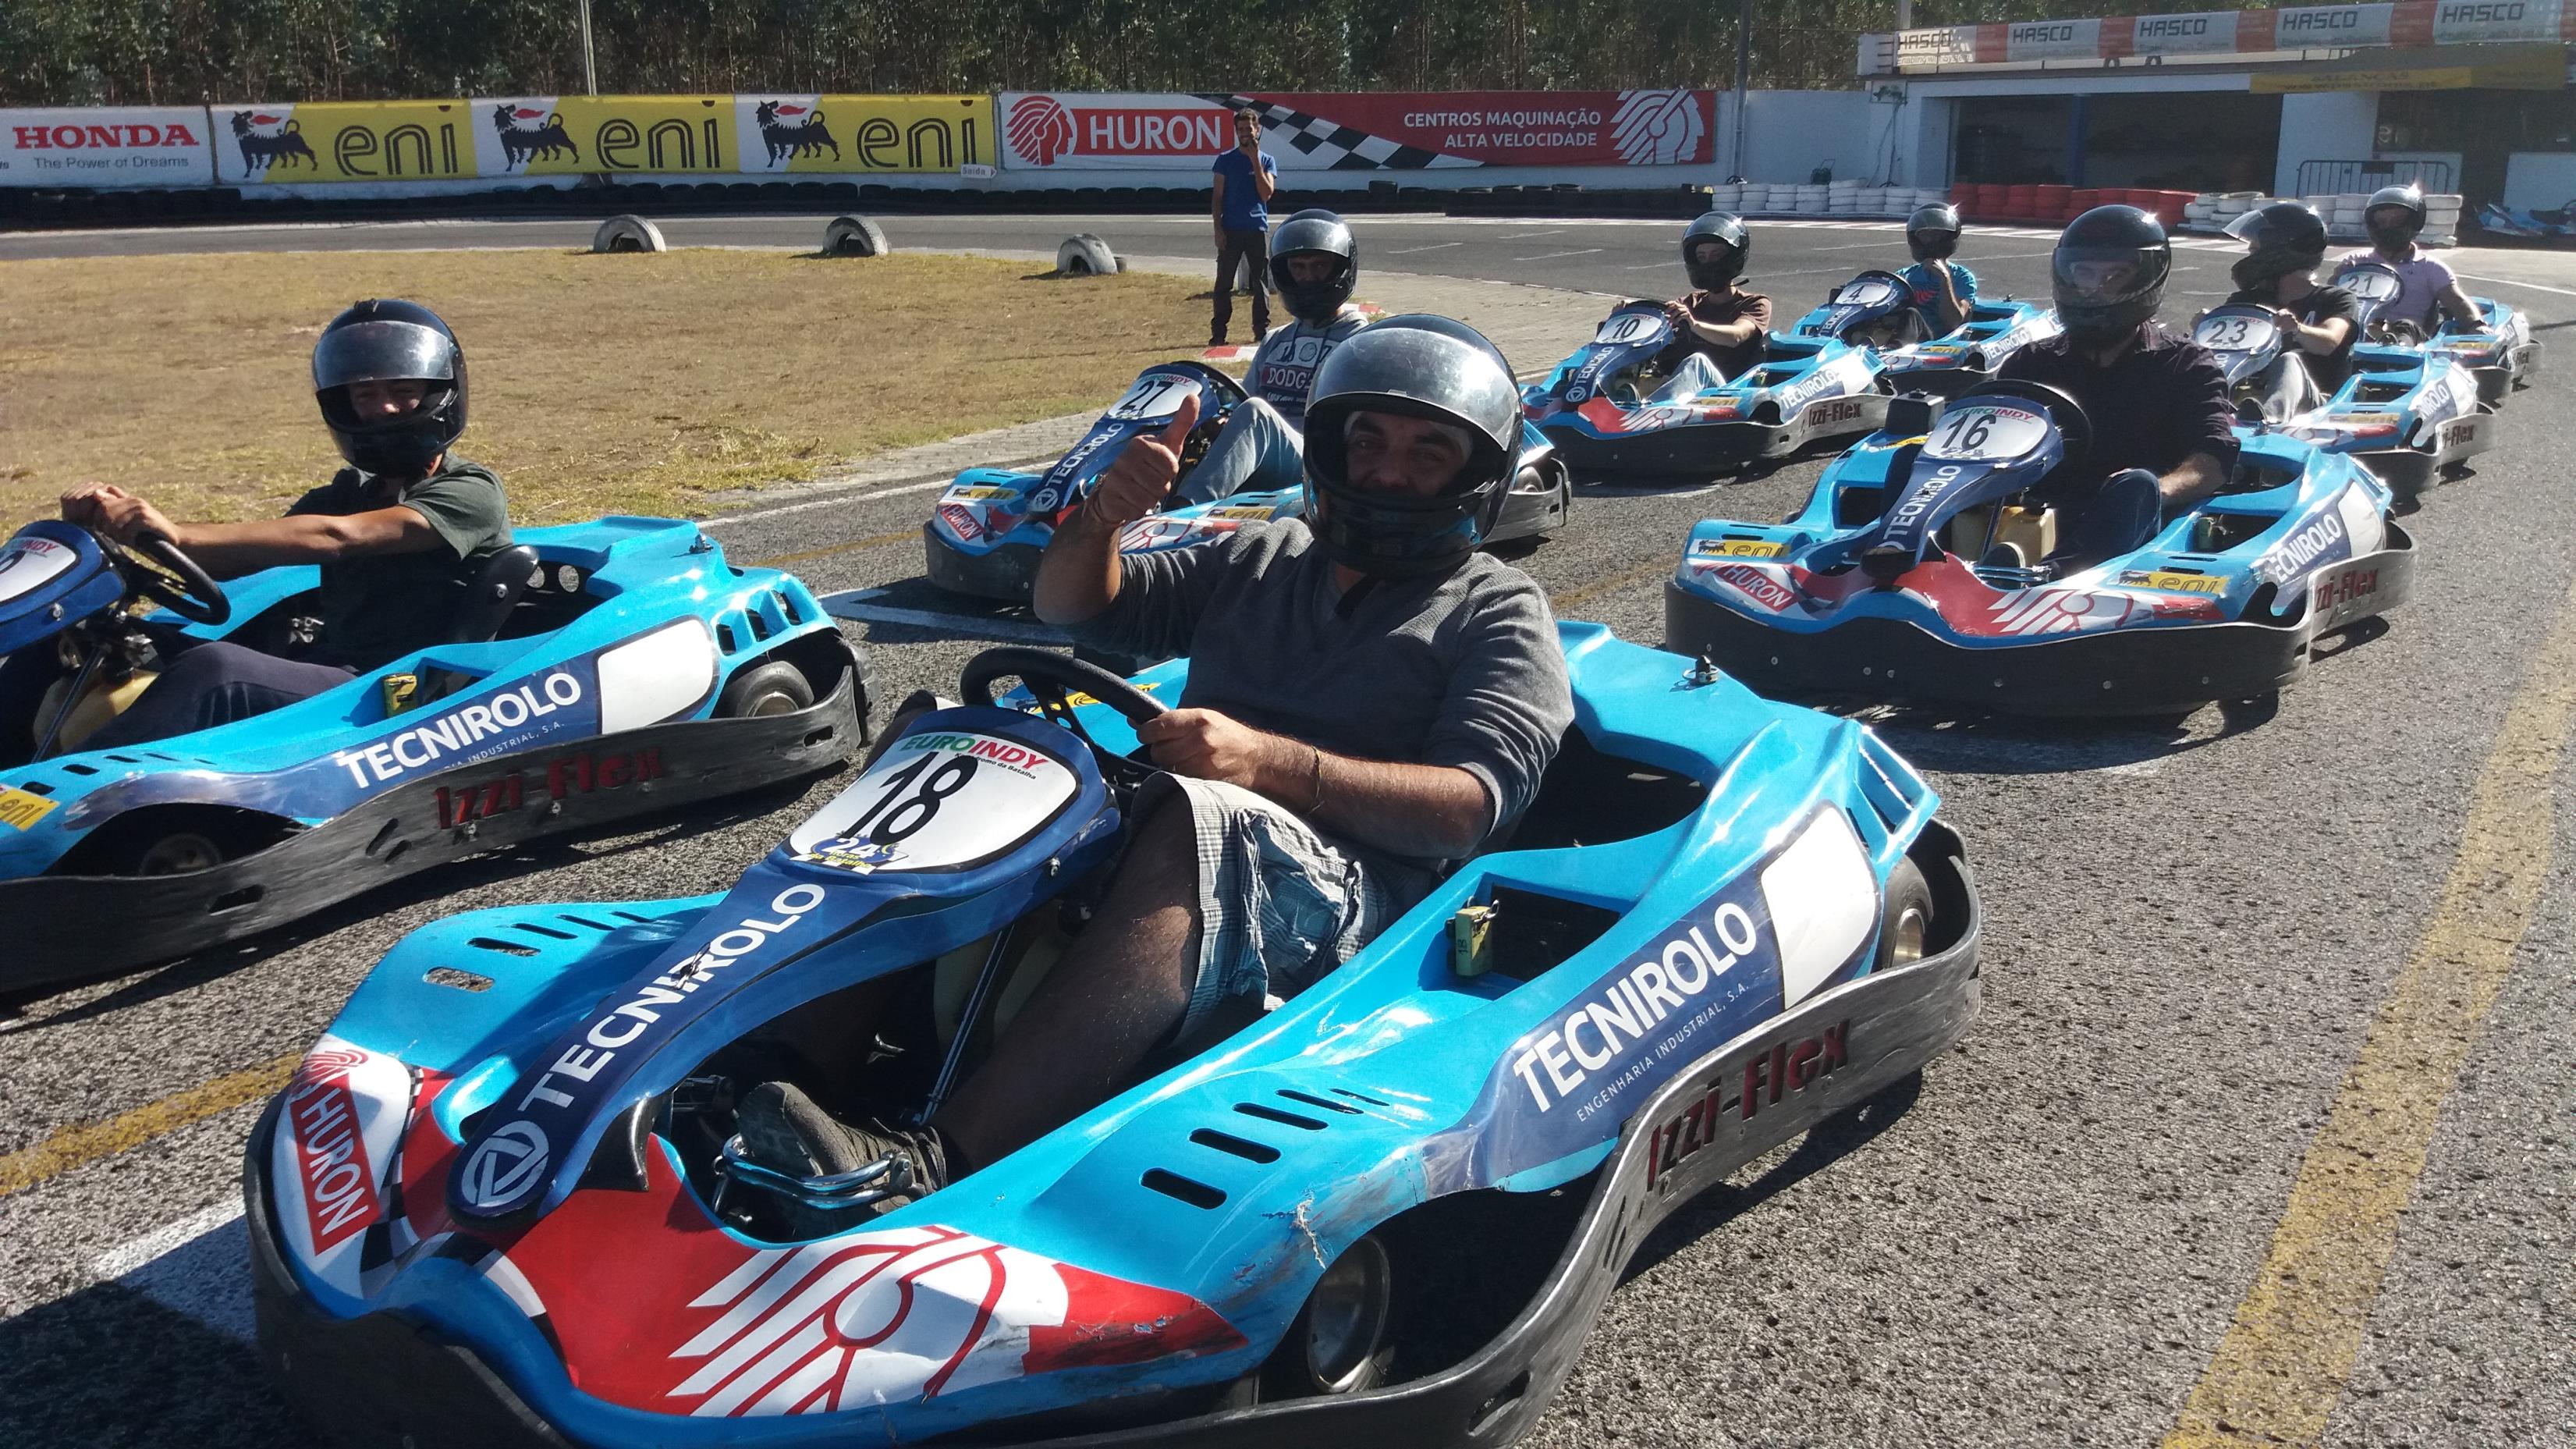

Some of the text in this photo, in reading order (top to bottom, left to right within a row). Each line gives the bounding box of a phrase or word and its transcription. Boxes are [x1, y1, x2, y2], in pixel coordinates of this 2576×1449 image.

[2283, 11, 2358, 30] HASCO
[2442, 3, 2525, 23] HASCO
[2013, 26, 2073, 44] HASCO
[2139, 19, 2207, 37] HASCO
[1898, 34, 1950, 50] HASCO
[1404, 108, 1602, 130] CENTROS MAQUINAÇÃO
[12, 125, 200, 149] HONDA
[334, 105, 459, 176] eni
[597, 100, 721, 169] eni
[857, 100, 977, 169] eni
[1089, 115, 1221, 151] HURON
[1444, 131, 1597, 148] ALTA VELOCIDADE
[34, 155, 189, 169] The Power of Dreams
[1848, 285, 1865, 301] 4
[2347, 275, 2374, 293] 21
[1611, 318, 1641, 339] 10
[2205, 320, 2248, 343] 23
[1119, 380, 1175, 410] 27
[1780, 370, 1839, 410] TECNIROLO
[1941, 412, 1997, 451] 16
[1723, 563, 1793, 608] HURON
[2158, 576, 2223, 593] eni
[336, 672, 582, 789] TECNIROLO
[467, 721, 566, 763] INDUSTRIAL, S.A.
[899, 735, 1049, 770] EUROINDY
[1007, 764, 1037, 780] Batalha
[843, 751, 979, 844] 18
[821, 837, 882, 859] 24
[1513, 902, 1757, 1113] TECNIROLO
[1577, 983, 1750, 1122] ENGENHARIA INDUSTRIAL, S.A.
[300, 1084, 370, 1237] HURON
